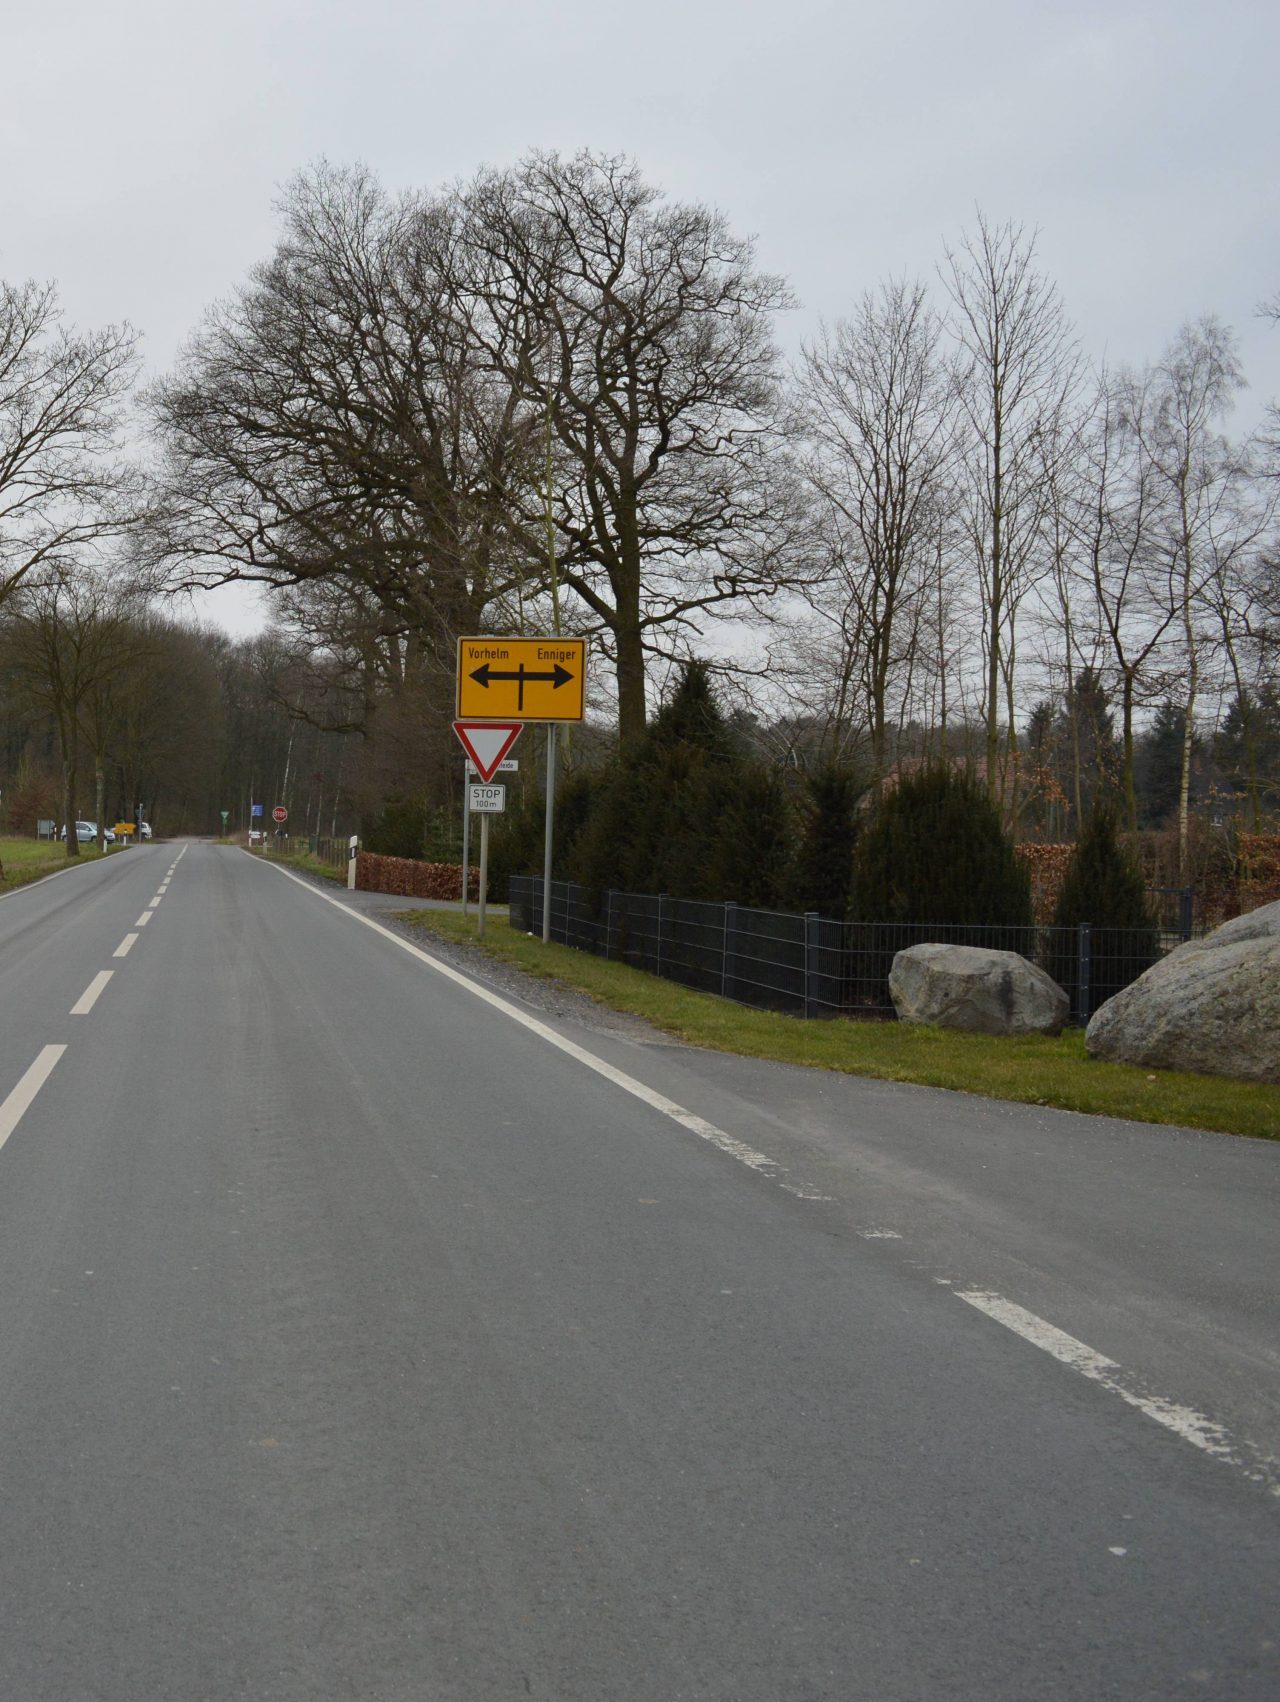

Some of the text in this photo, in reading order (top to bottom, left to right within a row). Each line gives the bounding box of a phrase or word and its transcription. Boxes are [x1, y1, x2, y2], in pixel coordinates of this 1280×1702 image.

[468, 647, 509, 659] Vorhelm
[537, 648, 576, 662] Enniger
[473, 789, 500, 798] STOP
